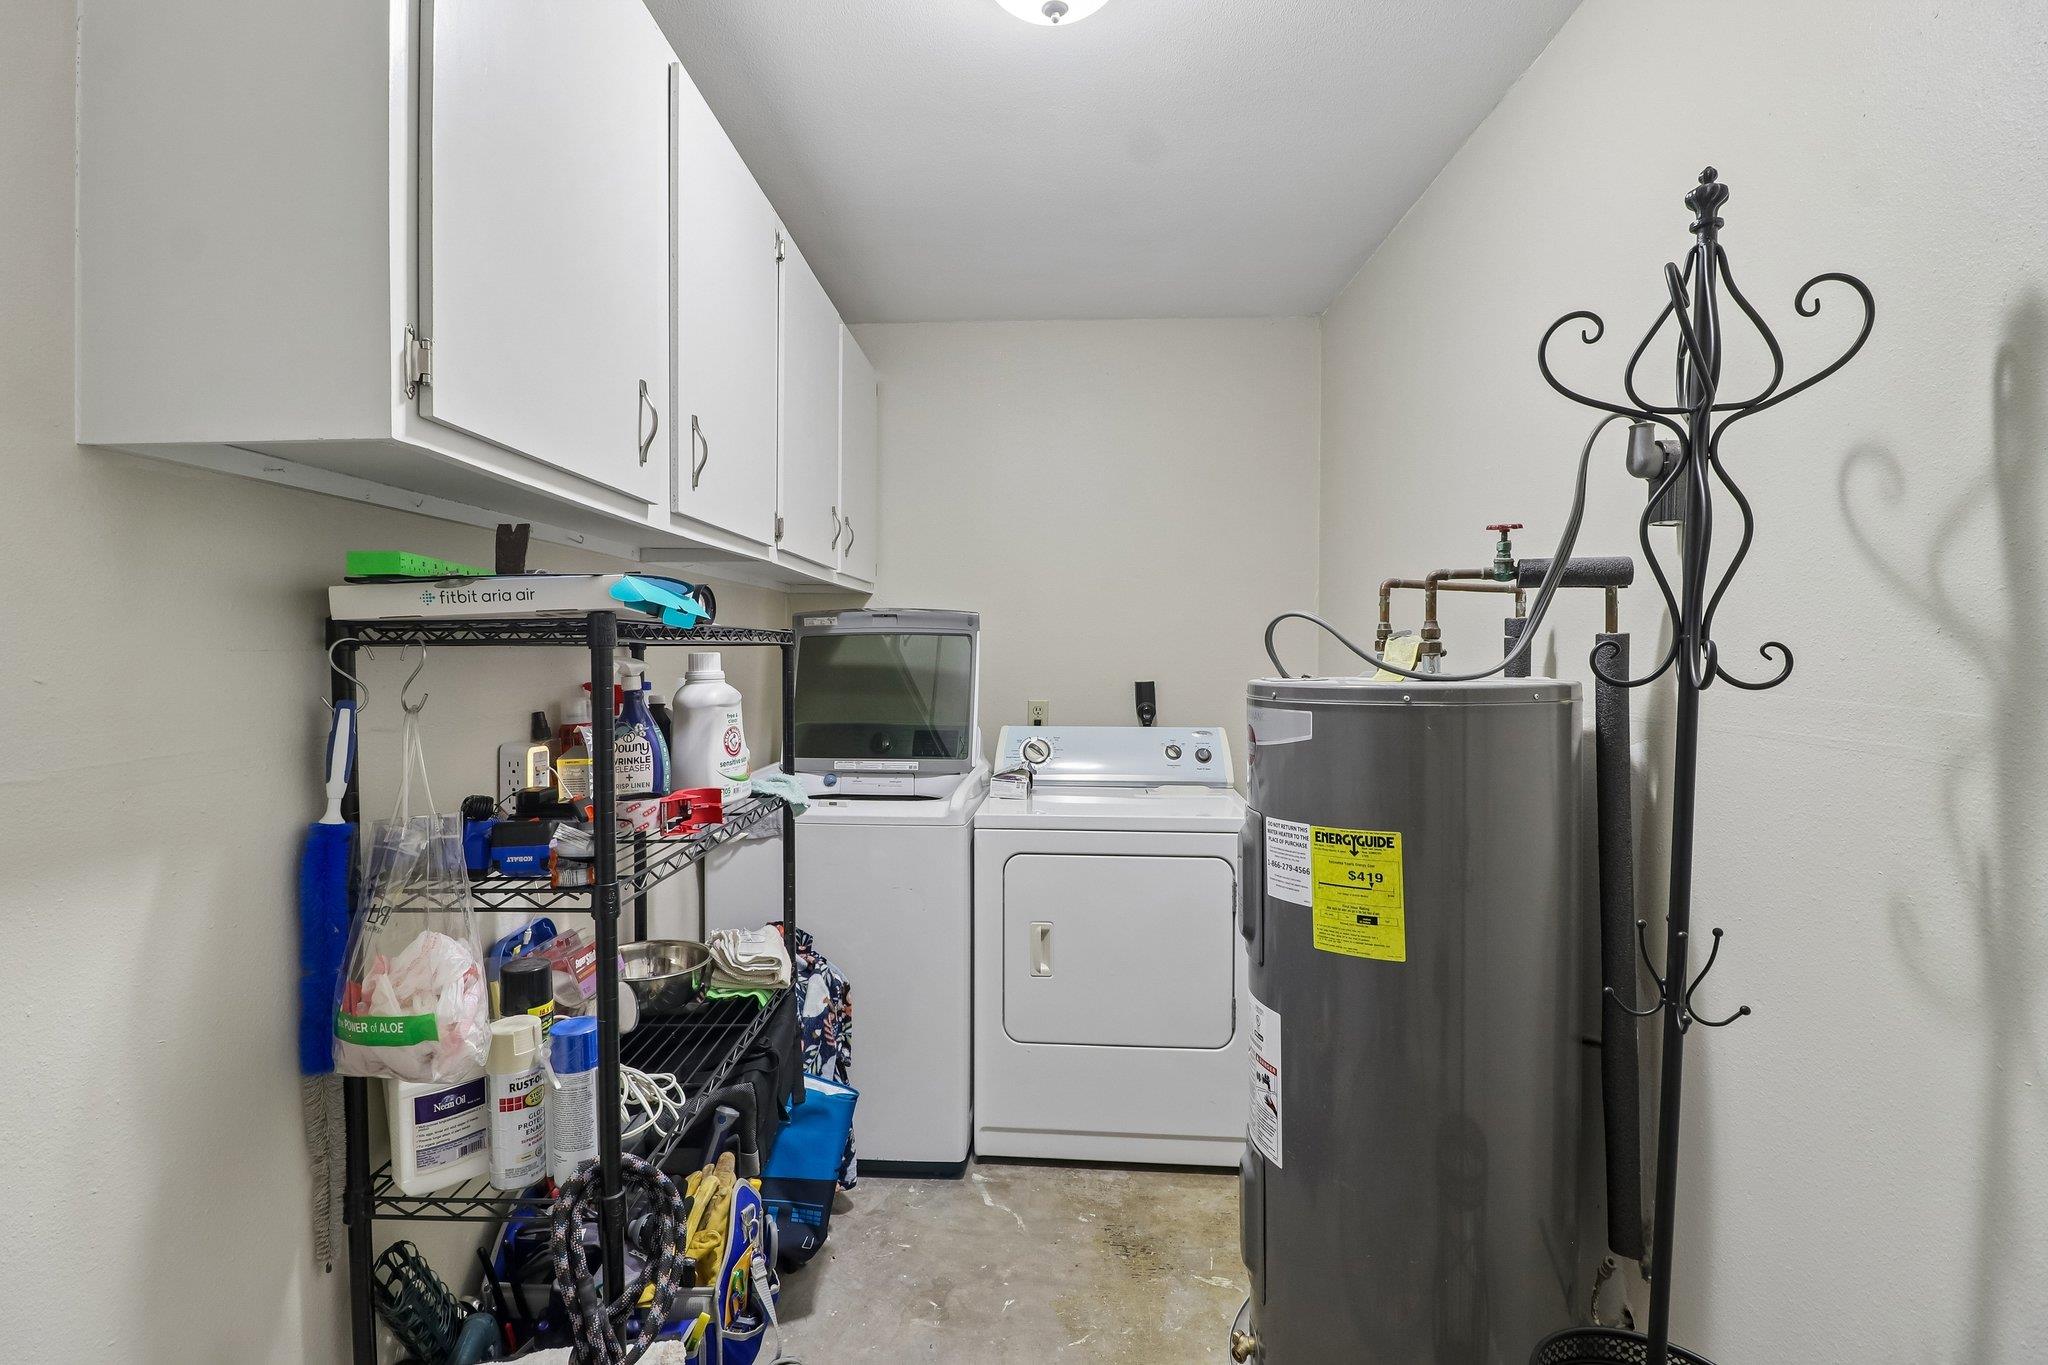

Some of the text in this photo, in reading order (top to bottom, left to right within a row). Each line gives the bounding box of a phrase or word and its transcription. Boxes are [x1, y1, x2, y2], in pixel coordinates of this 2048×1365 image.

[439, 588, 536, 604] fitbit aria air
[615, 764, 651, 774] ELEASER
[1281, 823, 1297, 832] RETURN
[1297, 826, 1308, 834] THIS
[1284, 839, 1308, 849] PURCHASE
[1314, 831, 1395, 849] ENERGYGUIDE
[1348, 870, 1384, 883] $419
[344, 1019, 368, 1033] POWER
[370, 1022, 378, 1033] of
[380, 1022, 404, 1033] ALOE
[433, 1100, 455, 1113] Neem
[455, 1094, 466, 1106] Oil
